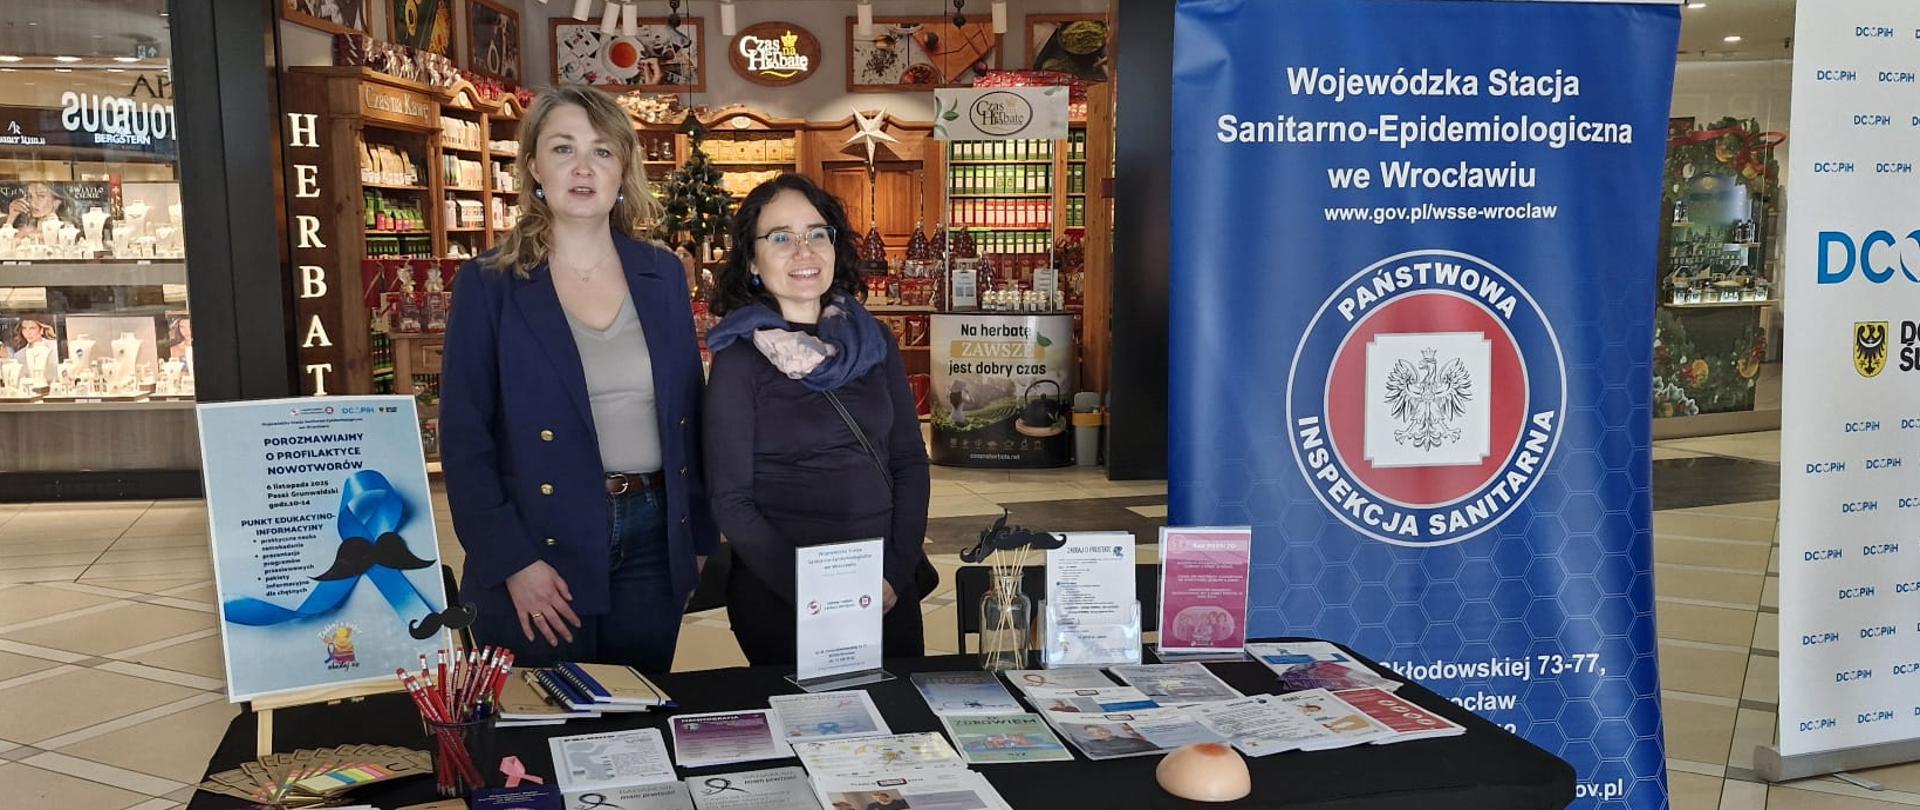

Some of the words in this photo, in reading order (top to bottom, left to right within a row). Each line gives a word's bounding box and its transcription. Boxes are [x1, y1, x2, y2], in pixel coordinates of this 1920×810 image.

[740, 36, 780, 56] Czas
[782, 47, 797, 55] na
[1287, 67, 1478, 102] Wojewódzka
[1488, 68, 1580, 103] Stacja
[95, 133, 150, 145] BERGSTERN
[1217, 114, 1633, 149] Sanitarno-Epidemiologiczna
[1328, 168, 1371, 189] we
[1380, 160, 1536, 188] Wrocławiu
[1324, 203, 1557, 224] www.gov.pl/wsse-wroclaw
[1337, 262, 1517, 321] PAŃSTWOWA
[961, 324, 977, 336] Na
[981, 324, 1032, 339] herbatę
[961, 342, 1034, 357] ZAWSZE
[949, 361, 972, 376] jest
[976, 361, 1013, 377] dobry
[1016, 364, 1046, 375] czas
[264, 432, 364, 447] POROZMAWIAJMY
[266, 452, 274, 461] O
[277, 447, 361, 460] PROFILAKTYCE
[267, 460, 363, 475] NOWOTWORÓW
[1299, 416, 1419, 536] INSPEKCJA
[1429, 410, 1555, 535] SANITARNA
[273, 481, 309, 490] listopada
[241, 518, 272, 527] PUNKT
[275, 512, 336, 524] EDUKACYJNO-
[256, 524, 323, 536] INFORMACYJNY
[1538, 652, 1606, 676] 73-77,
[1575, 778, 1624, 801] ov.pl
